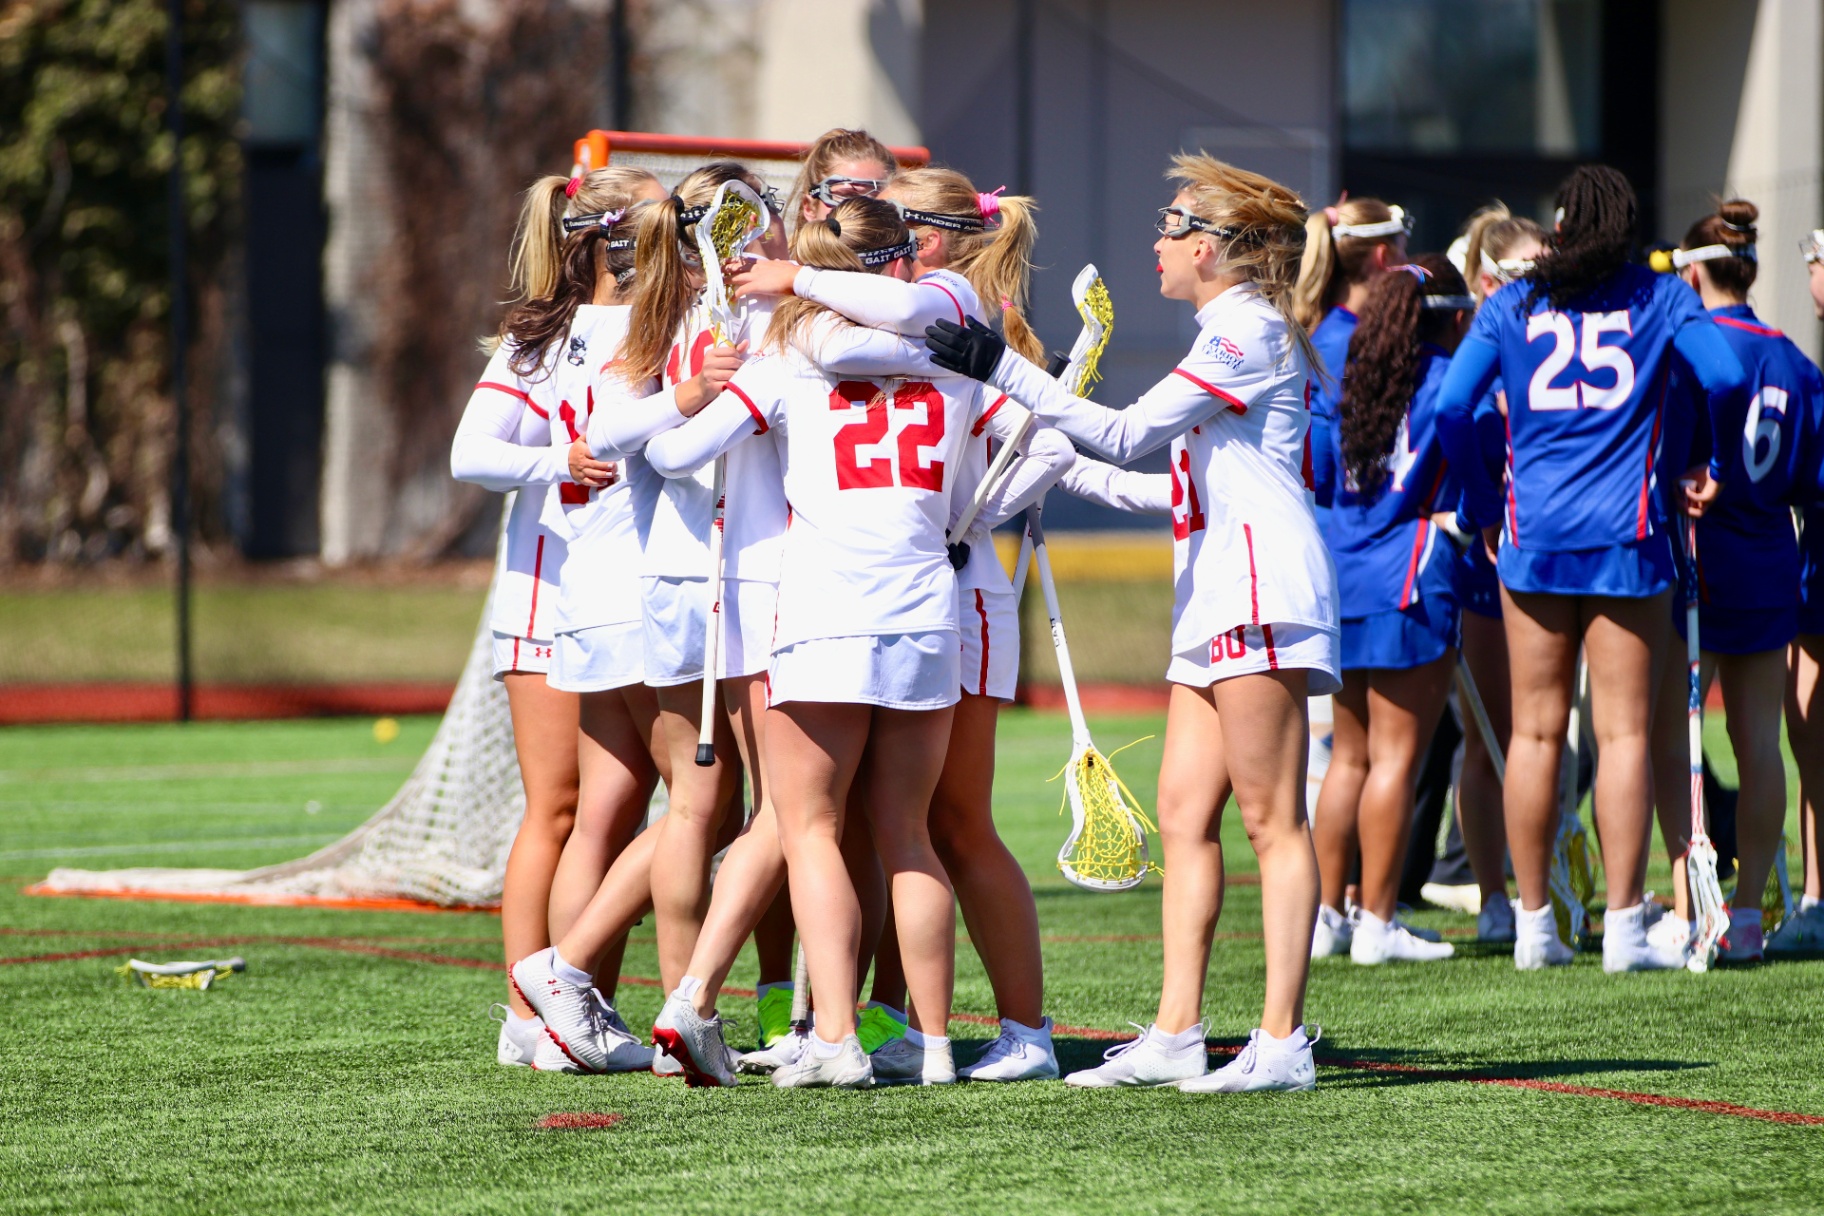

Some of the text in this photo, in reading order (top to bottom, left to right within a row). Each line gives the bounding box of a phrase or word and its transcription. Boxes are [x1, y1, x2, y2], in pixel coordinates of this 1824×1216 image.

[610, 239, 630, 248] GAIT
[920, 215, 962, 229] UNDER
[865, 254, 891, 265] GAIT
[893, 245, 912, 259] GAIT
[1526, 309, 1635, 411] 25
[829, 380, 945, 493] 22
[1743, 386, 1788, 483] 6
